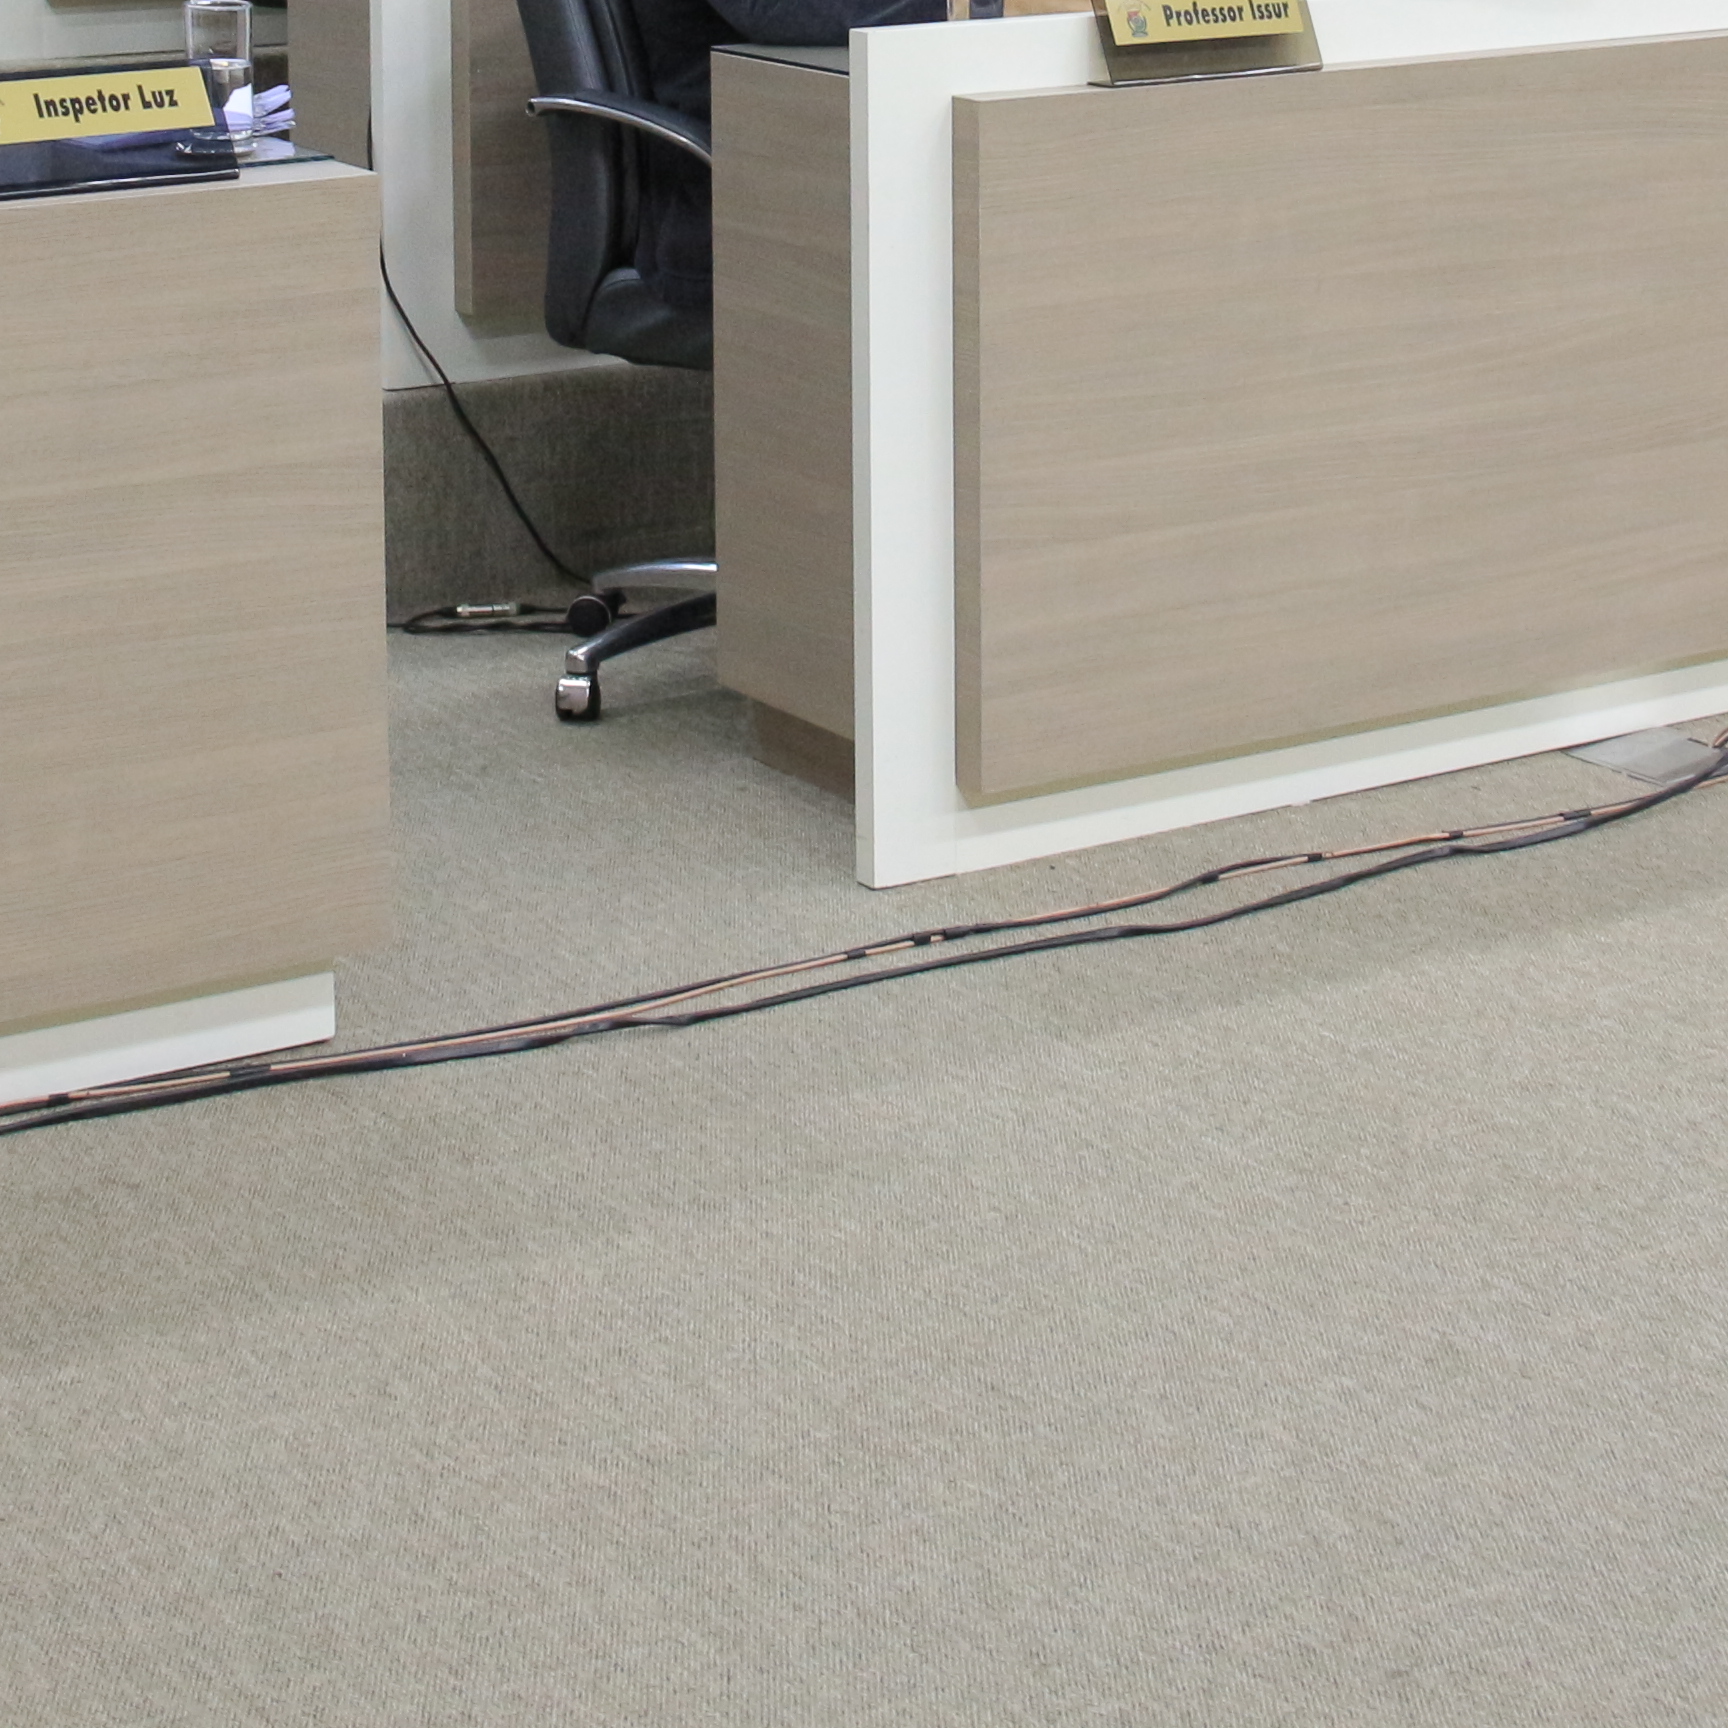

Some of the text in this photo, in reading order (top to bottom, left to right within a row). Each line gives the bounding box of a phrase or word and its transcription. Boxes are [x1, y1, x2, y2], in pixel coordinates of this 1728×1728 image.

[1161, 0, 1244, 28] Professor
[33, 88, 131, 123] Inspetor
[136, 84, 179, 110] Luz
